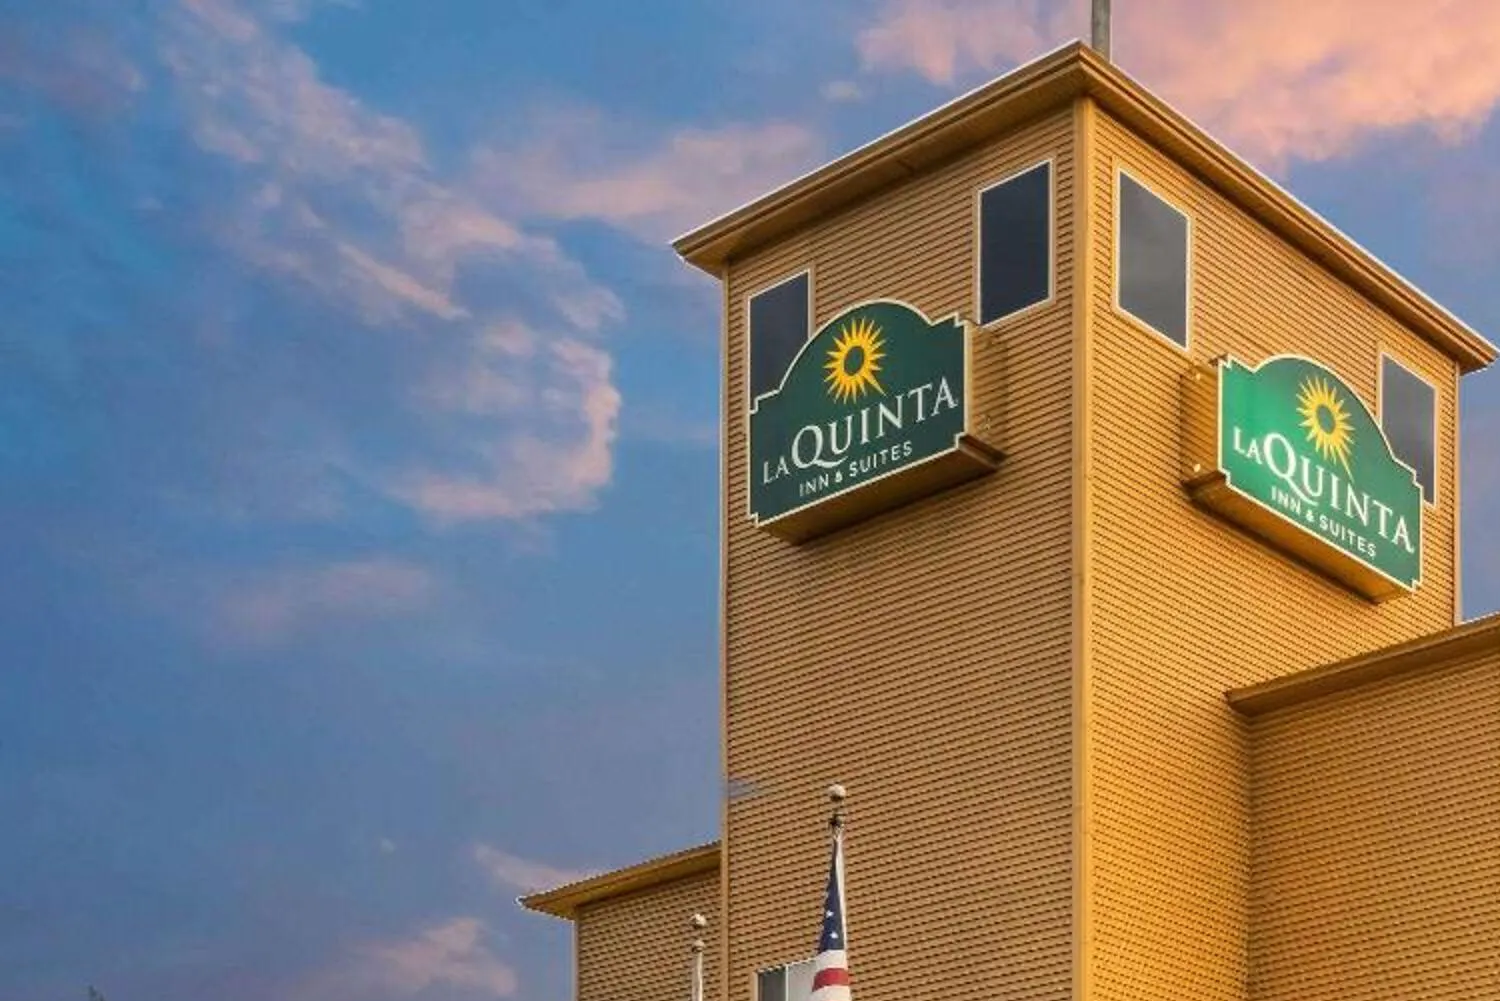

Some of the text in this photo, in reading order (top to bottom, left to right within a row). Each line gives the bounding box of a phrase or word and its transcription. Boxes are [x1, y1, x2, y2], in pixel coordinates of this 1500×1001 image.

[791, 376, 958, 469] QUINTA
[799, 473, 829, 497] INN
[849, 440, 913, 477] SUITES
[1263, 432, 1415, 555] QUINTA
[1271, 486, 1377, 559] INN & SUITES
